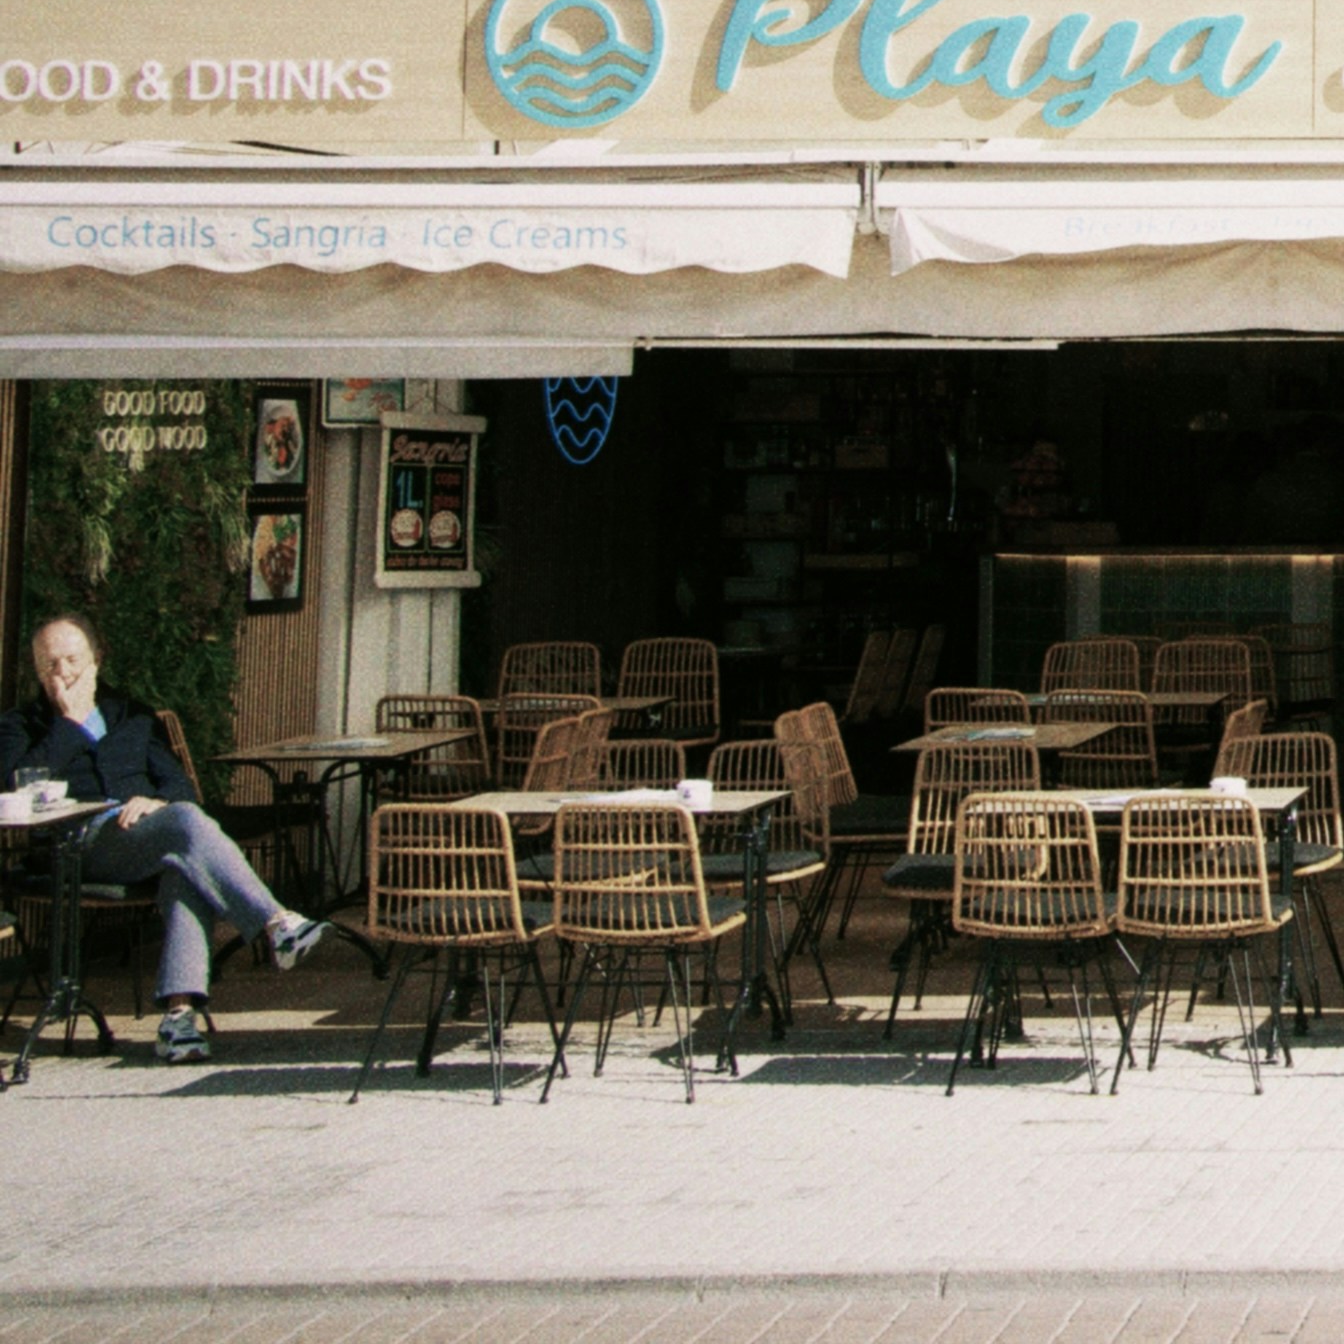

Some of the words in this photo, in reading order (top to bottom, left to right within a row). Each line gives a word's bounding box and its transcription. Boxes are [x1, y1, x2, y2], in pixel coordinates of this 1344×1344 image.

[136, 59, 172, 102] &
[190, 57, 393, 102] DRINKS
[46, 215, 217, 249] Cocktails
[422, 218, 474, 249] Ice
[488, 218, 628, 250] Creams
[103, 390, 156, 417] GOOD
[160, 390, 206, 416] FOOD
[101, 426, 156, 453] GOOD
